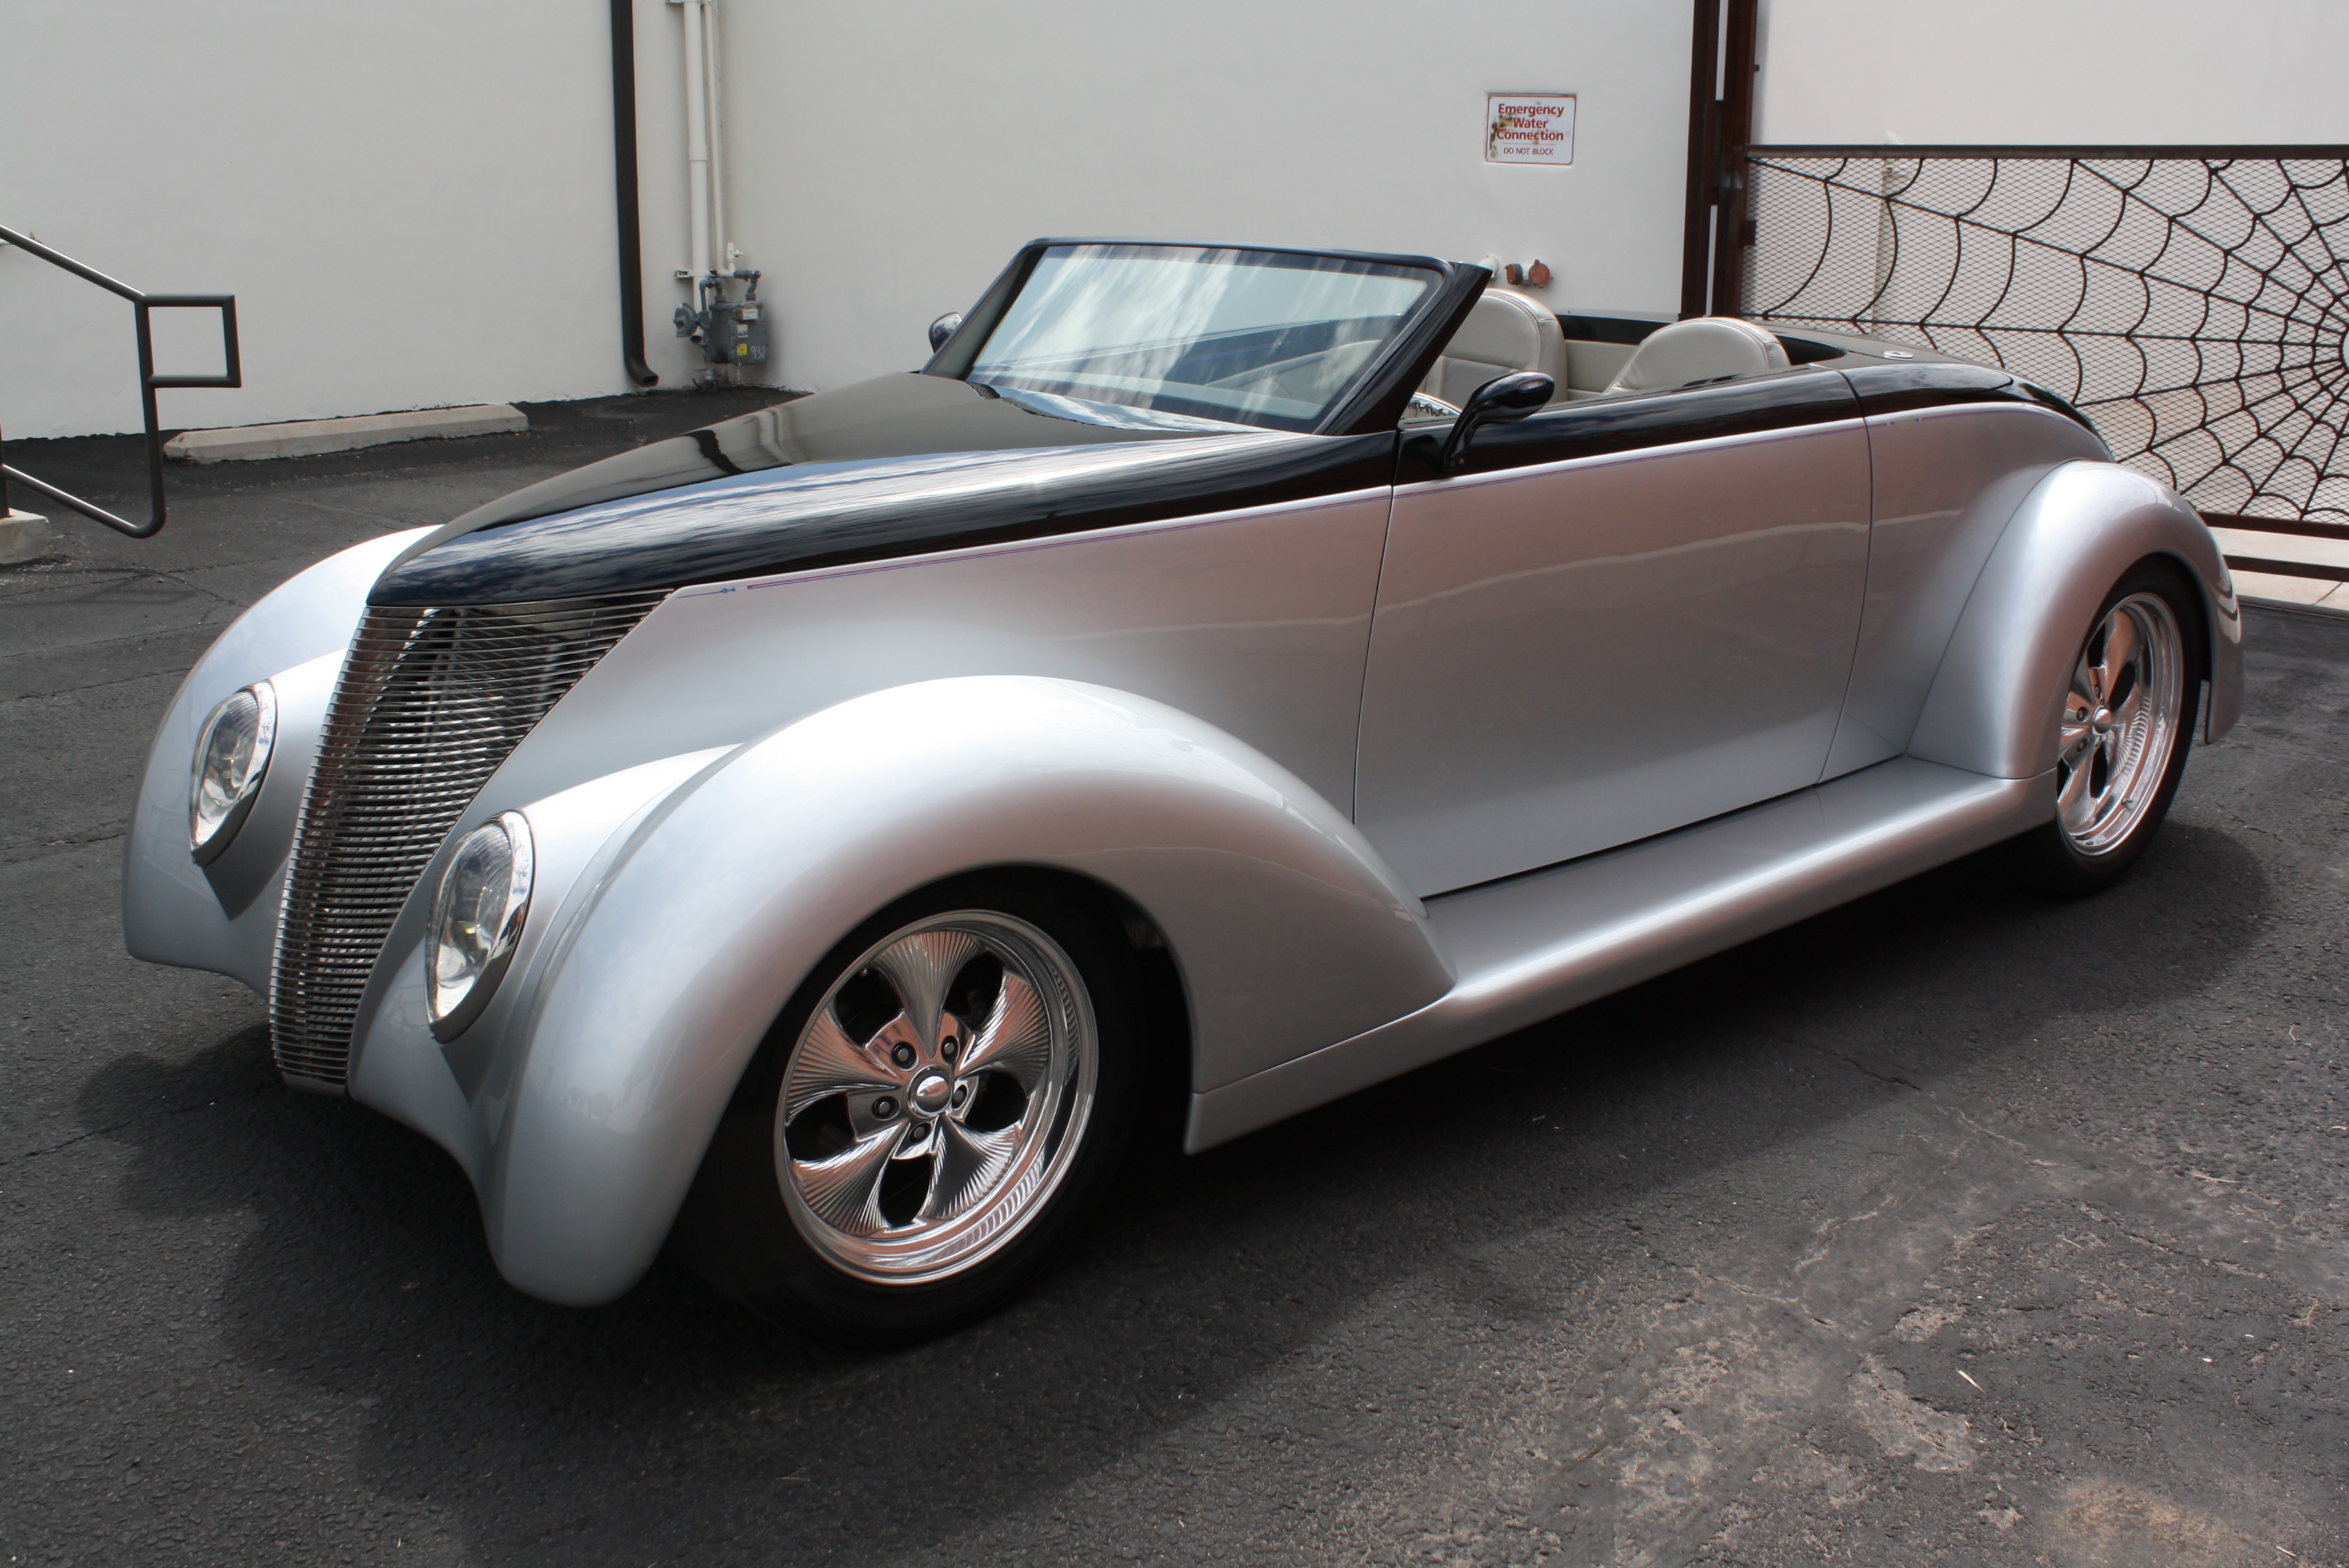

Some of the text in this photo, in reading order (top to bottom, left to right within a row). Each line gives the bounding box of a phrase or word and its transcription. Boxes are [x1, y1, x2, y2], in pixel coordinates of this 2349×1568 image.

[1498, 103, 1564, 117] Emergency
[1513, 118, 1548, 128] Water
[1496, 129, 1563, 140] Connection
